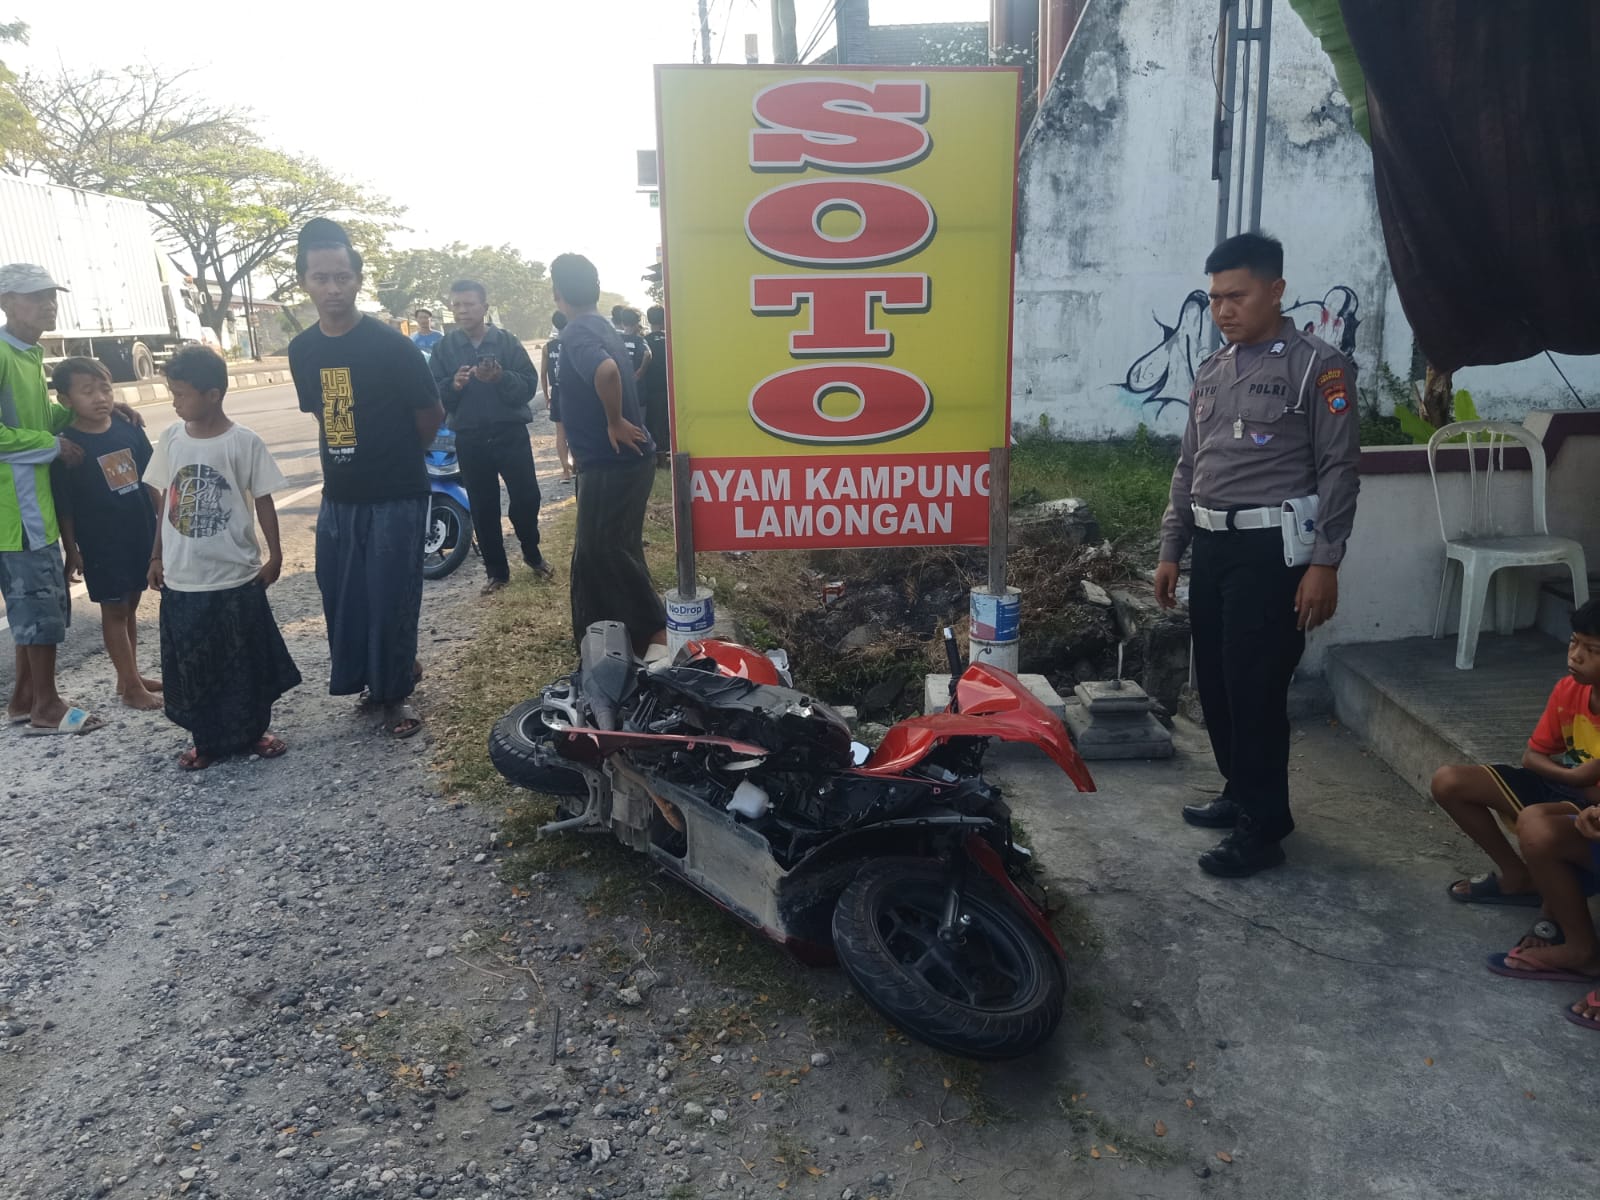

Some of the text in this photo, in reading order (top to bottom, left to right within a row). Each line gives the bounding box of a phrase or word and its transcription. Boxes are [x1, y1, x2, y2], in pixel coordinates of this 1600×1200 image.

[744, 77, 937, 446] SOTO
[1248, 383, 1287, 396] POLRI
[690, 464, 991, 502] AYAM KAMPUNG
[734, 502, 953, 538] LAMONGAN
